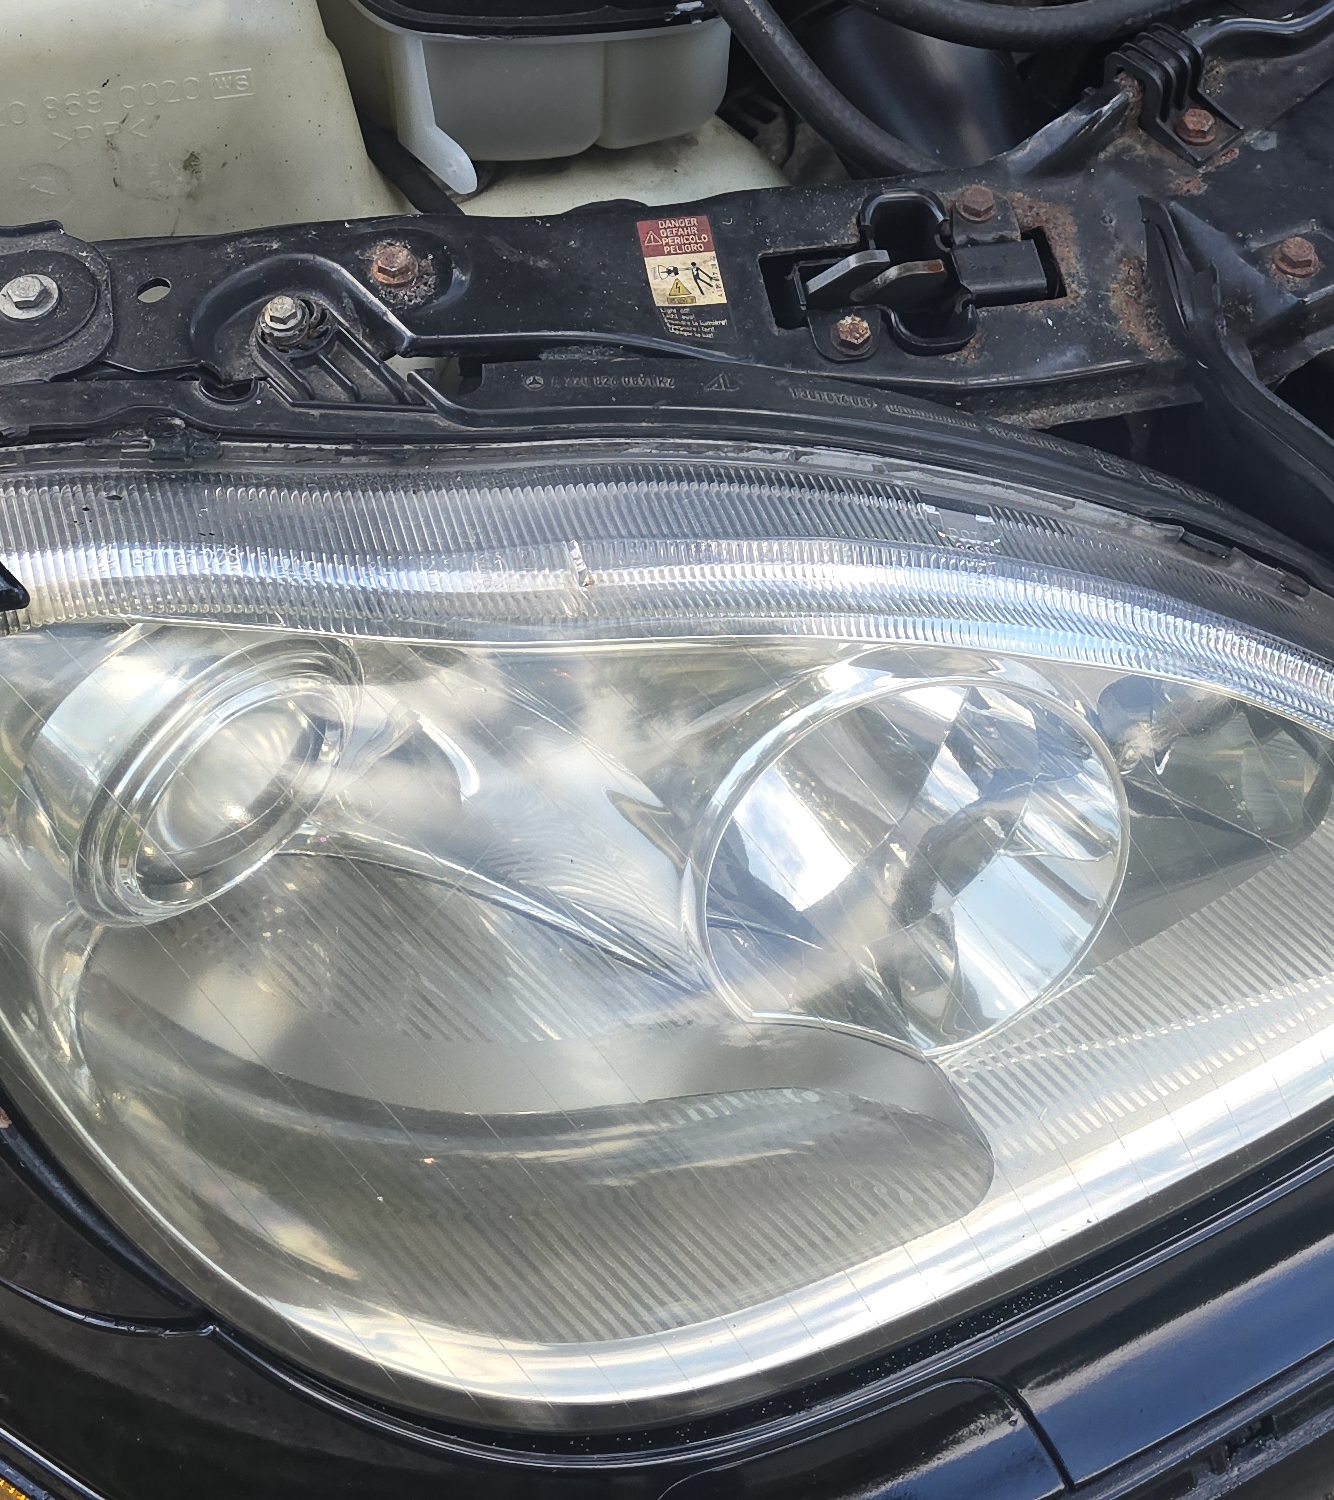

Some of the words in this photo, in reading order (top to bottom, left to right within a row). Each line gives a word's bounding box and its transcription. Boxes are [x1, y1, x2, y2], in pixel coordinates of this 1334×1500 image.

[659, 218, 698, 228] DANGER
[660, 226, 697, 237] GEFAHR
[661, 234, 708, 246] PERICOLO
[663, 244, 705, 254] PELIGRO
